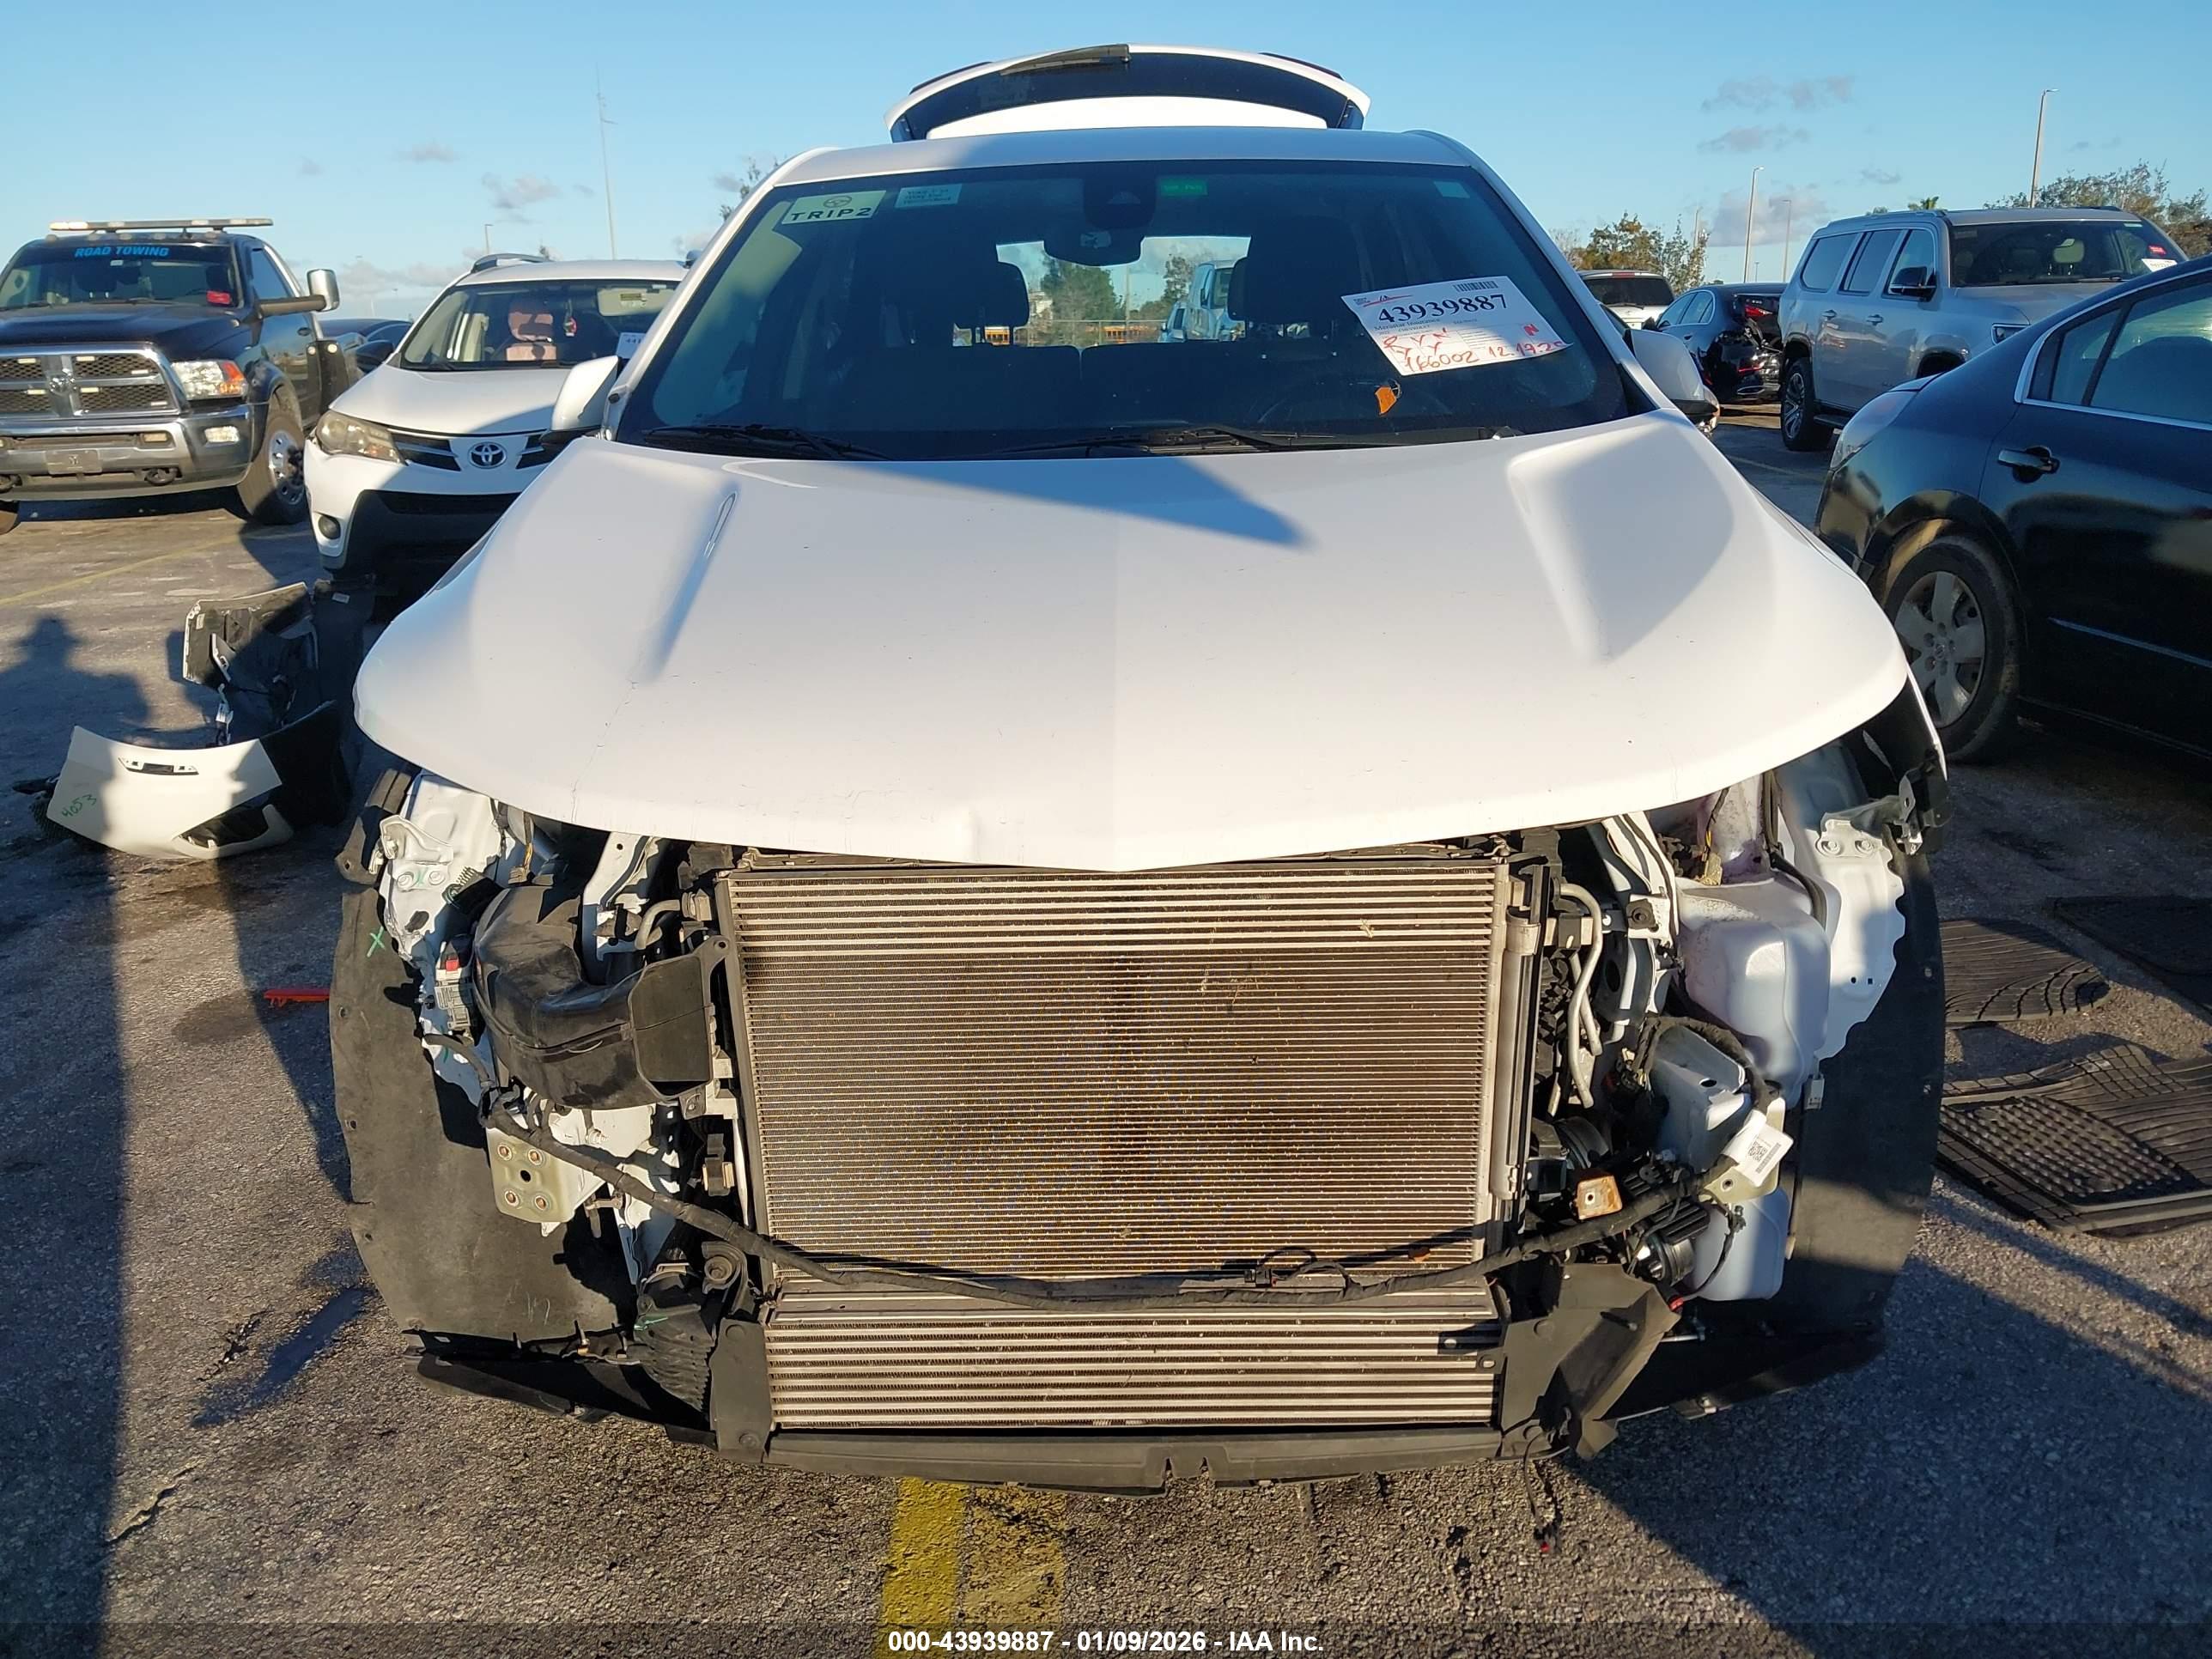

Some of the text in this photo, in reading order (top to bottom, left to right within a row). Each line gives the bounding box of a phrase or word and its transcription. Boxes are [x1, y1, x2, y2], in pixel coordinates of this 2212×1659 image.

[791, 207, 872, 221] TRIP2
[75, 246, 169, 258] ROAD TOWING
[1378, 294, 1507, 323] 43939887
